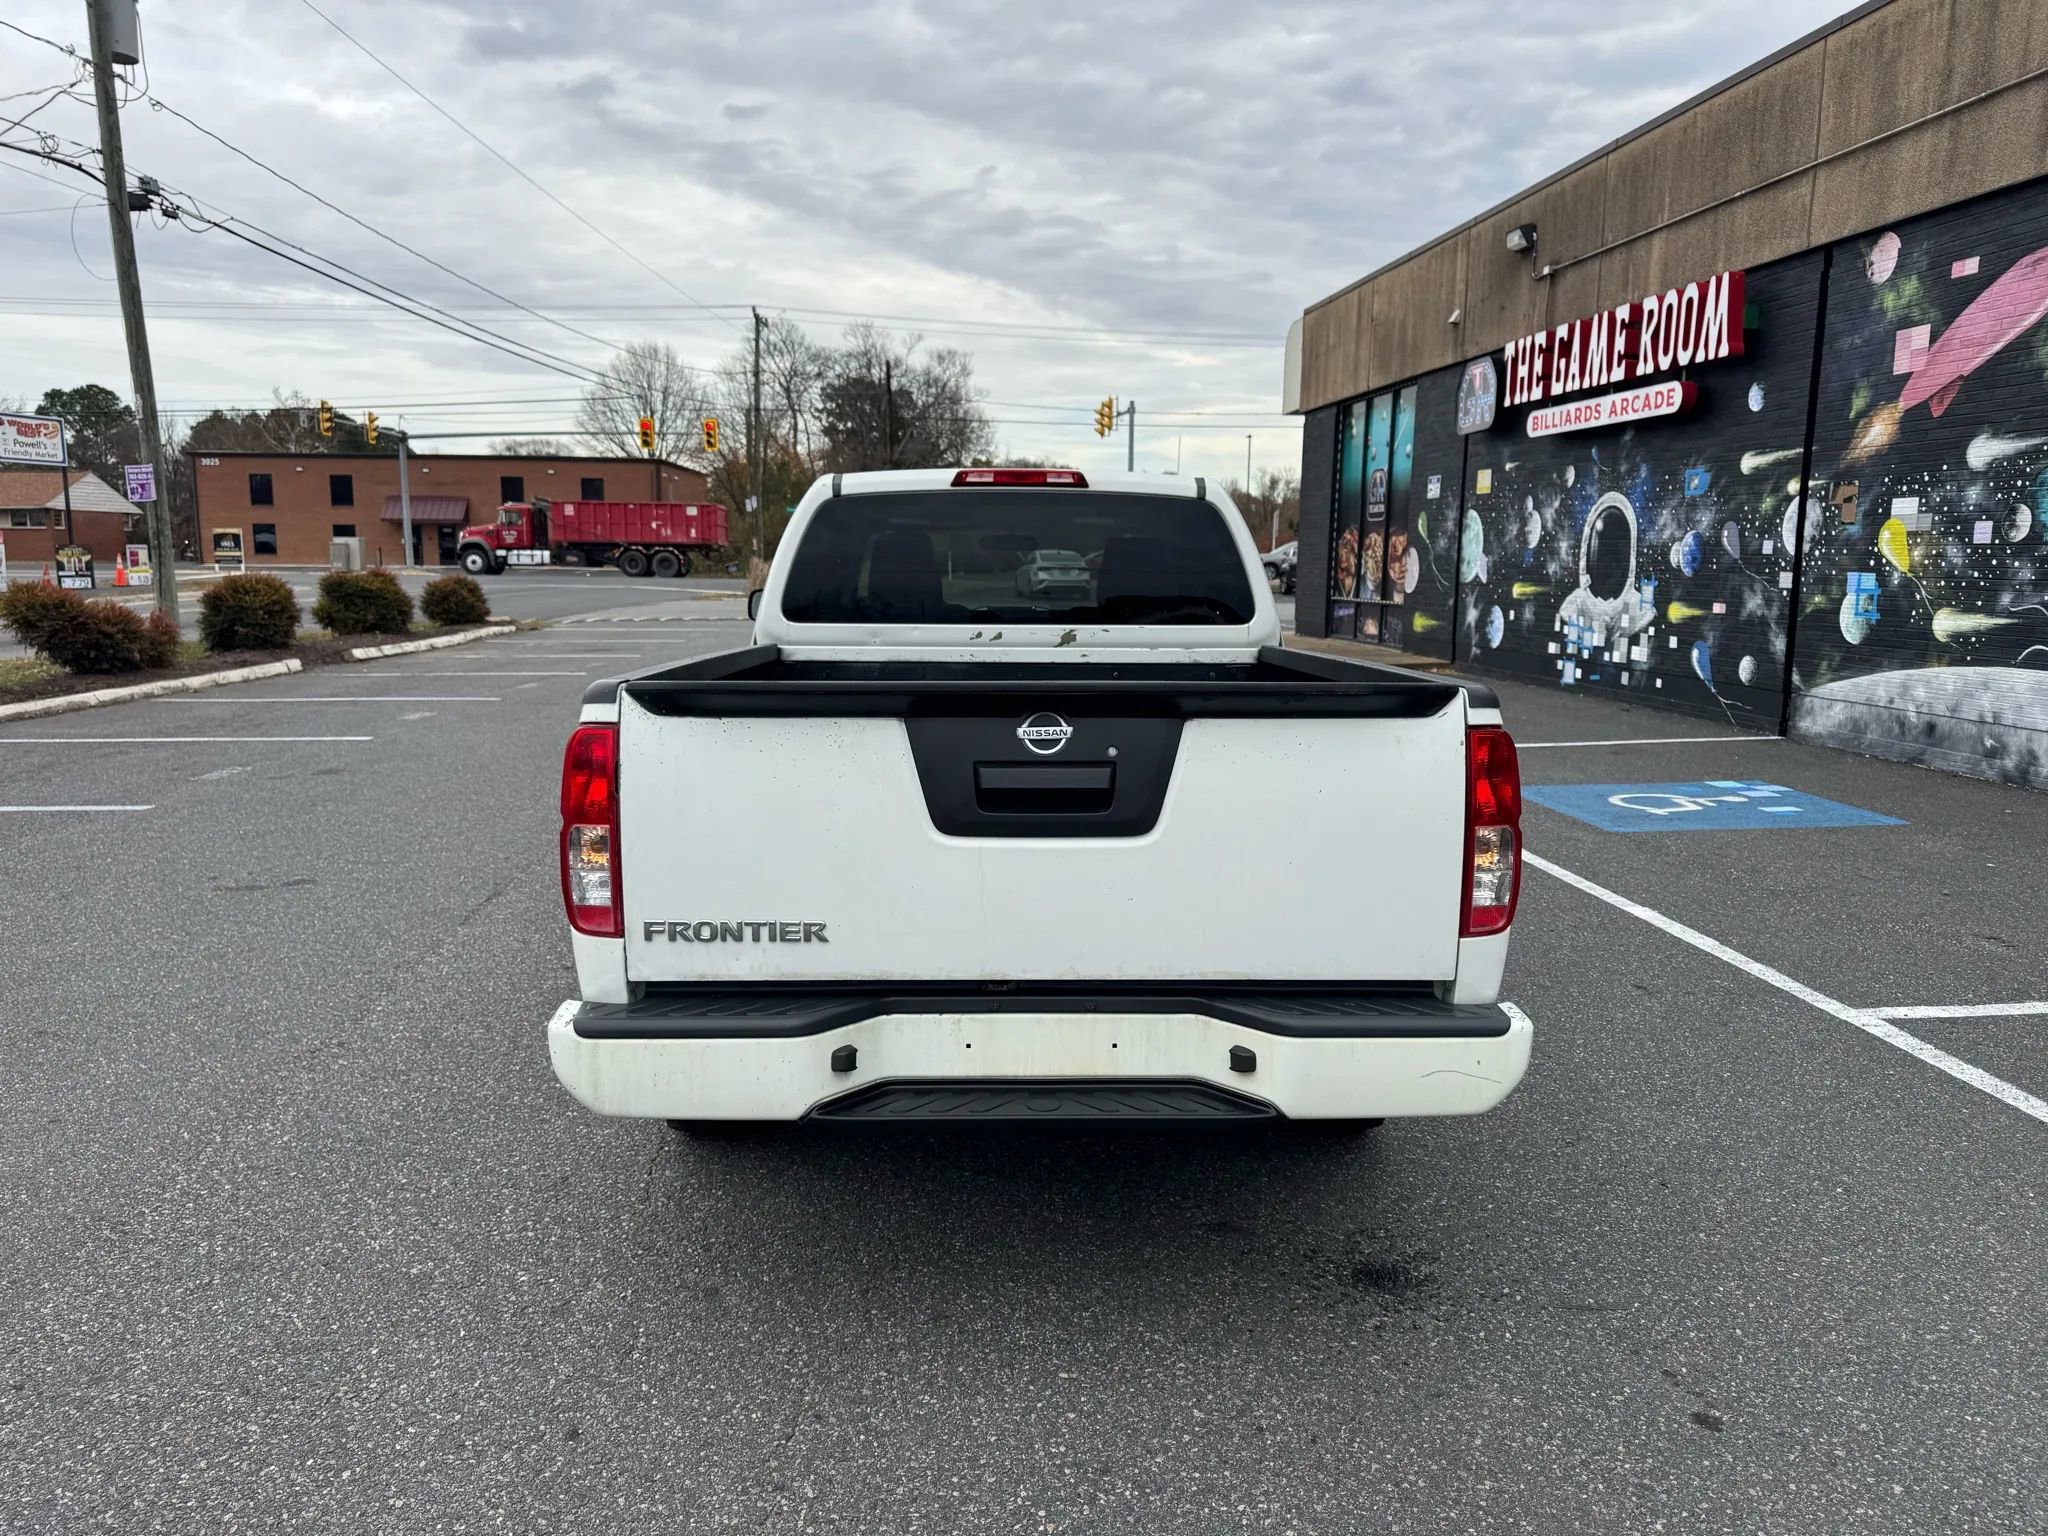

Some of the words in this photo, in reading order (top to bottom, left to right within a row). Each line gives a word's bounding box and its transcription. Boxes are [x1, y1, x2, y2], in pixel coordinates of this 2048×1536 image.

[1503, 330, 1547, 408] THE
[1551, 303, 1631, 397] GAME
[1636, 271, 1730, 377] ROOM
[1531, 403, 1601, 432] BILLIARDS
[1608, 388, 1676, 418] ARCADE
[16, 427, 42, 438] BEST
[13, 439, 47, 450] Powell's
[4, 448, 33, 457] Friendly
[35, 451, 58, 459] Market
[200, 457, 220, 466] 3925
[1022, 729, 1068, 737] NISSAN
[643, 920, 829, 943] FRONTIER
